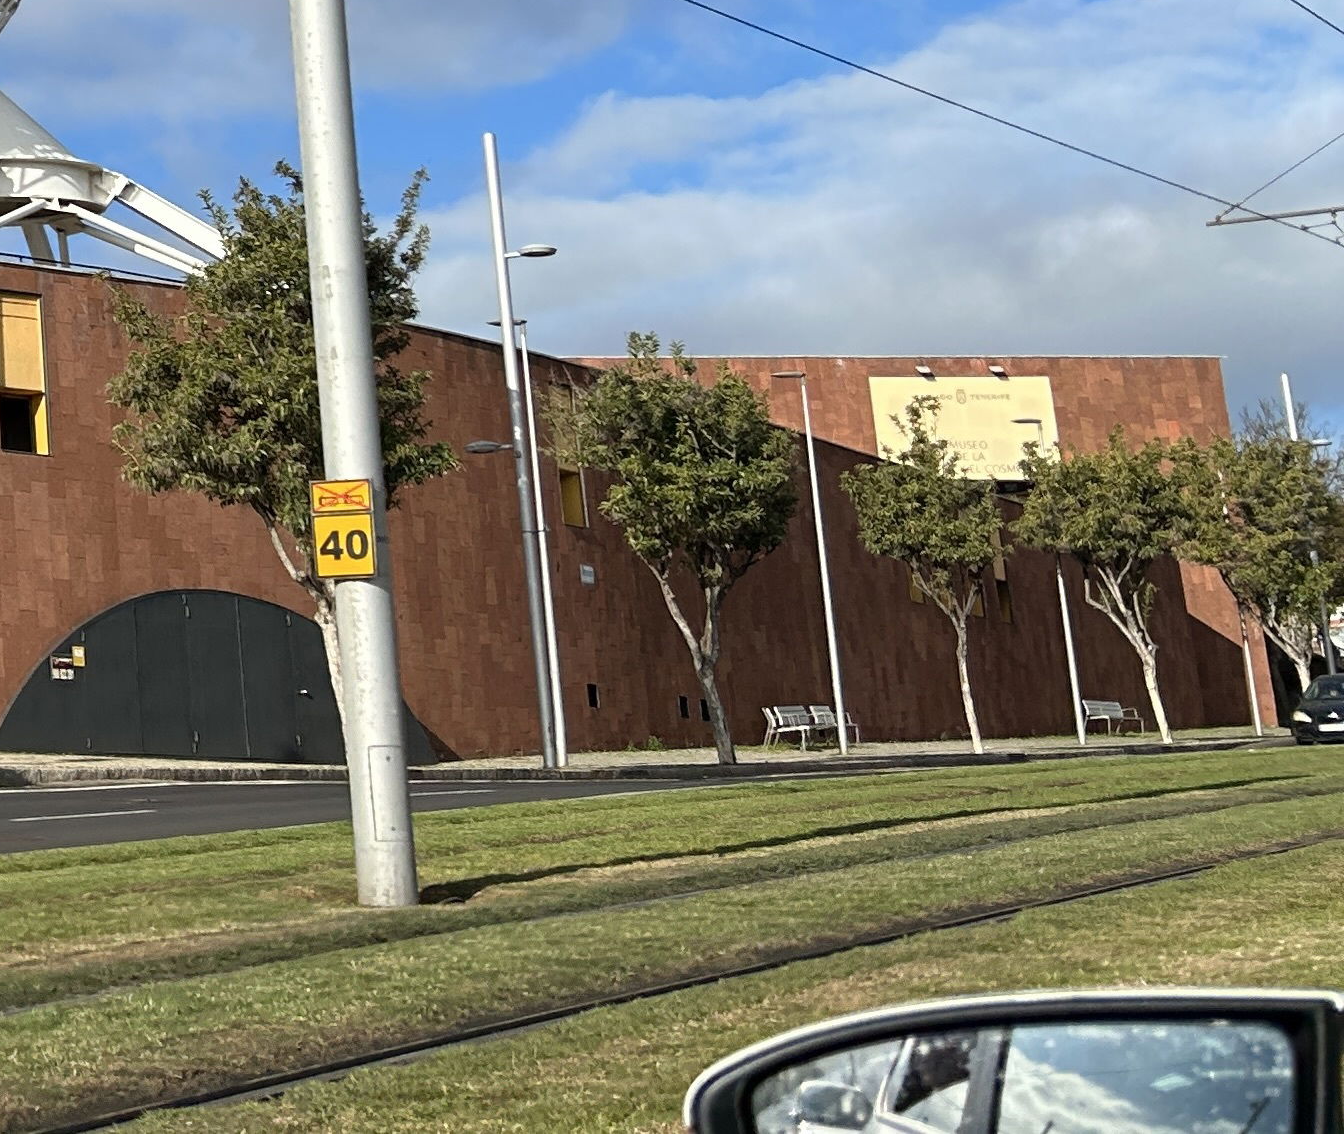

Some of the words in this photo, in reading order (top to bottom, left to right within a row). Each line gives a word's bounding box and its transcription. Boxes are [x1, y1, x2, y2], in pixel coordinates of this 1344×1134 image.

[972, 452, 985, 461] LA
[985, 465, 1021, 474] COSM
[319, 529, 369, 561] 40
